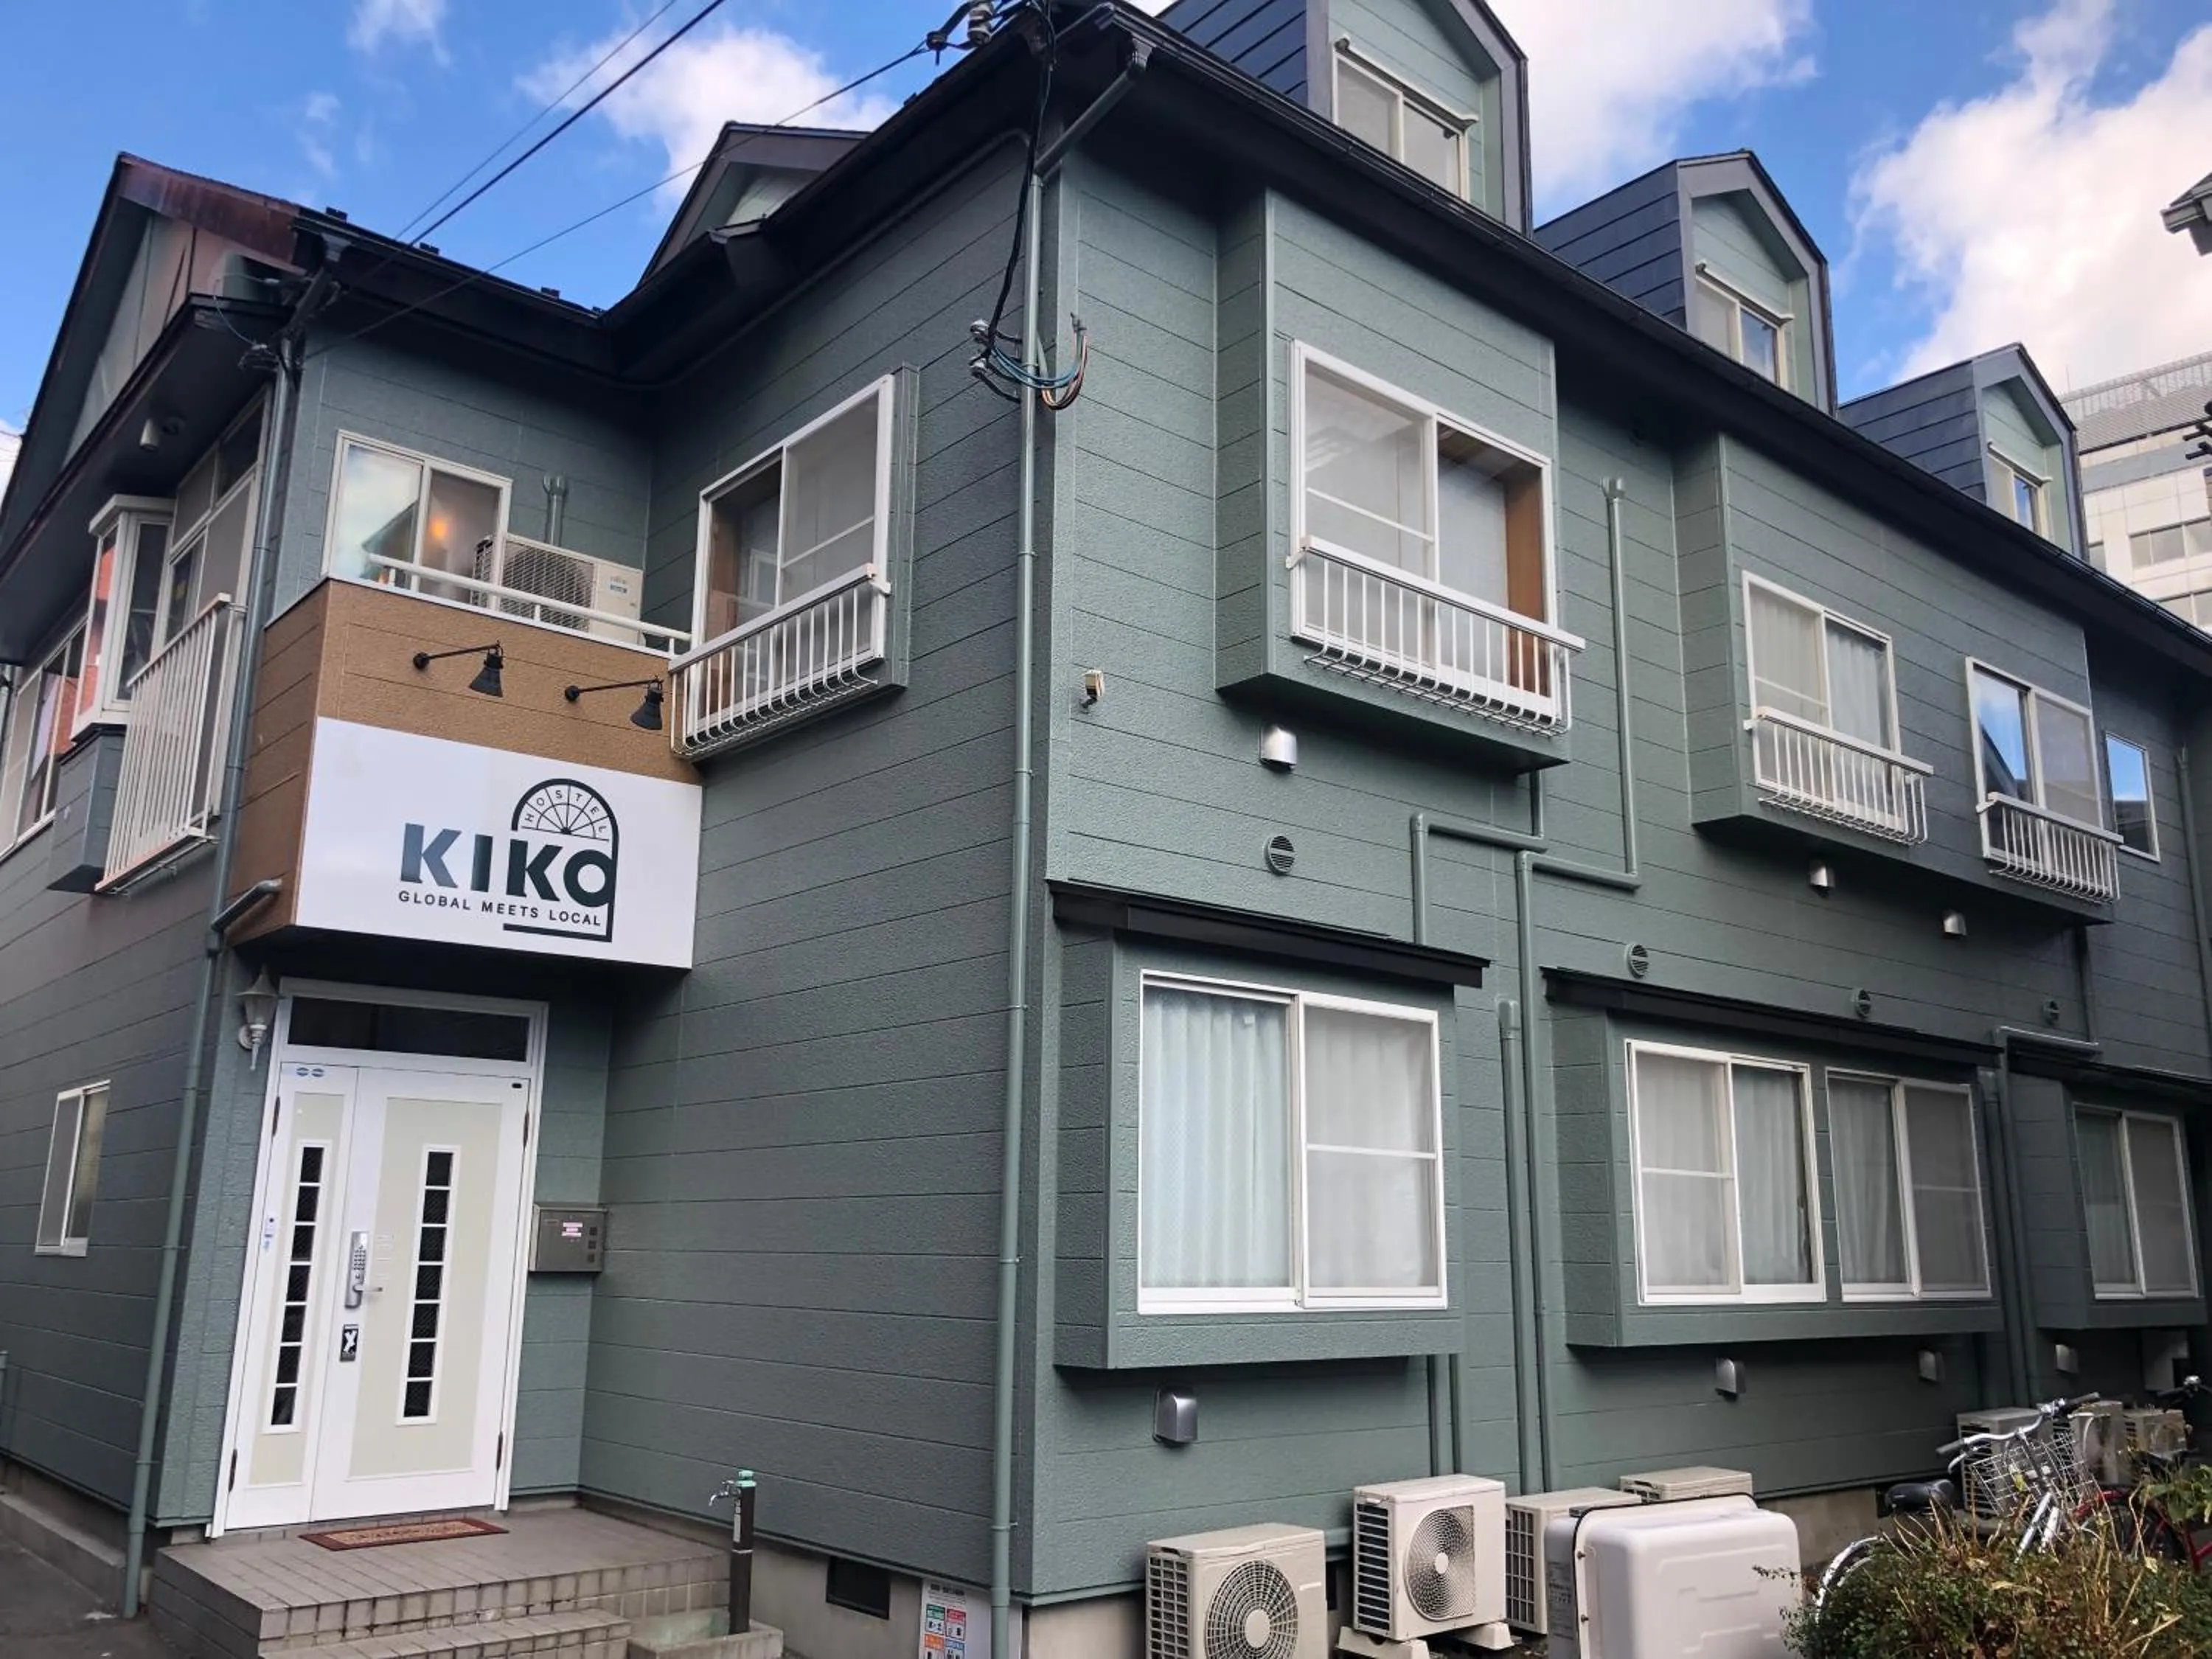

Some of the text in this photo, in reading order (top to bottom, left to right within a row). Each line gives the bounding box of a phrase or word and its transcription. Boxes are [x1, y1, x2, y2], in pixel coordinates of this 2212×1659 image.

[524, 790, 607, 832] HOSTEL
[400, 823, 614, 908] KIKO
[398, 890, 602, 927] GLOBAL MEETS LOCAL
